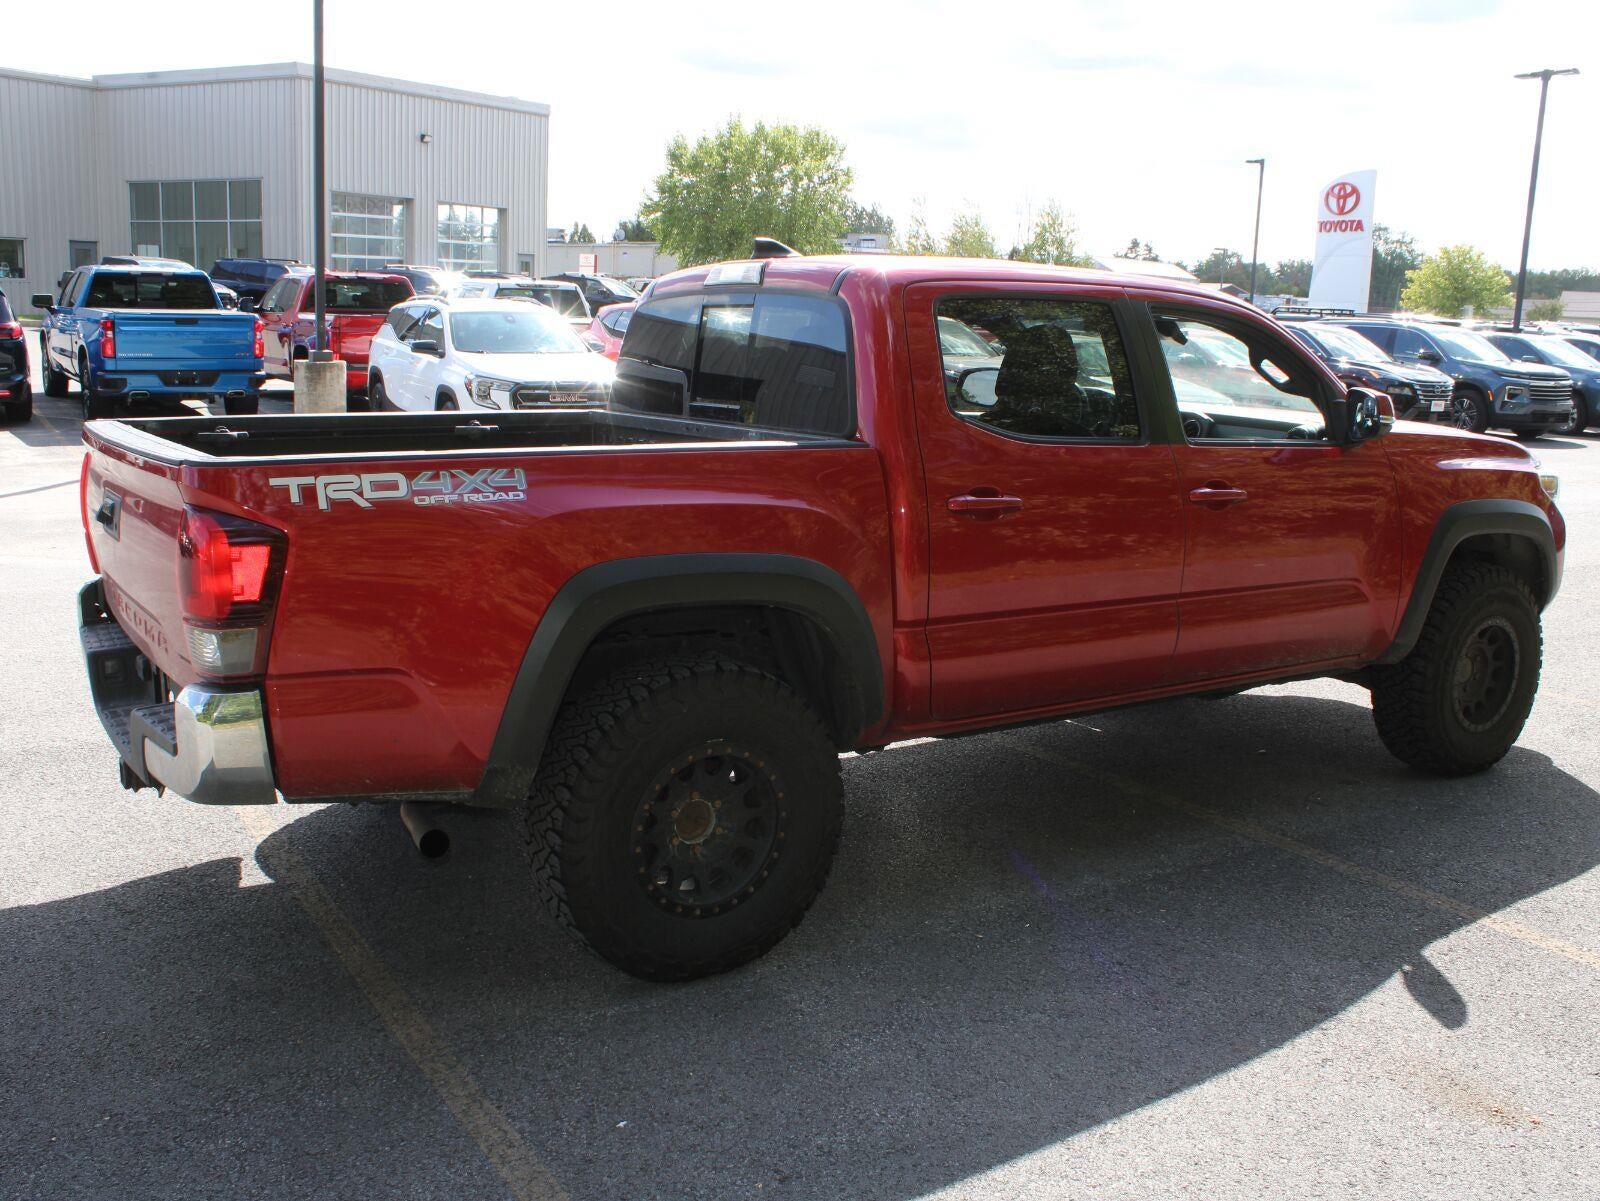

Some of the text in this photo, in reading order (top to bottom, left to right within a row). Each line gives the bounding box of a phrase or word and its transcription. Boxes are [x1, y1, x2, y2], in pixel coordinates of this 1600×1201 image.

[1317, 219, 1365, 233] TOYOTA
[549, 393, 588, 402] GMC
[269, 472, 411, 512] TRD
[413, 491, 527, 506] OFF ROAD
